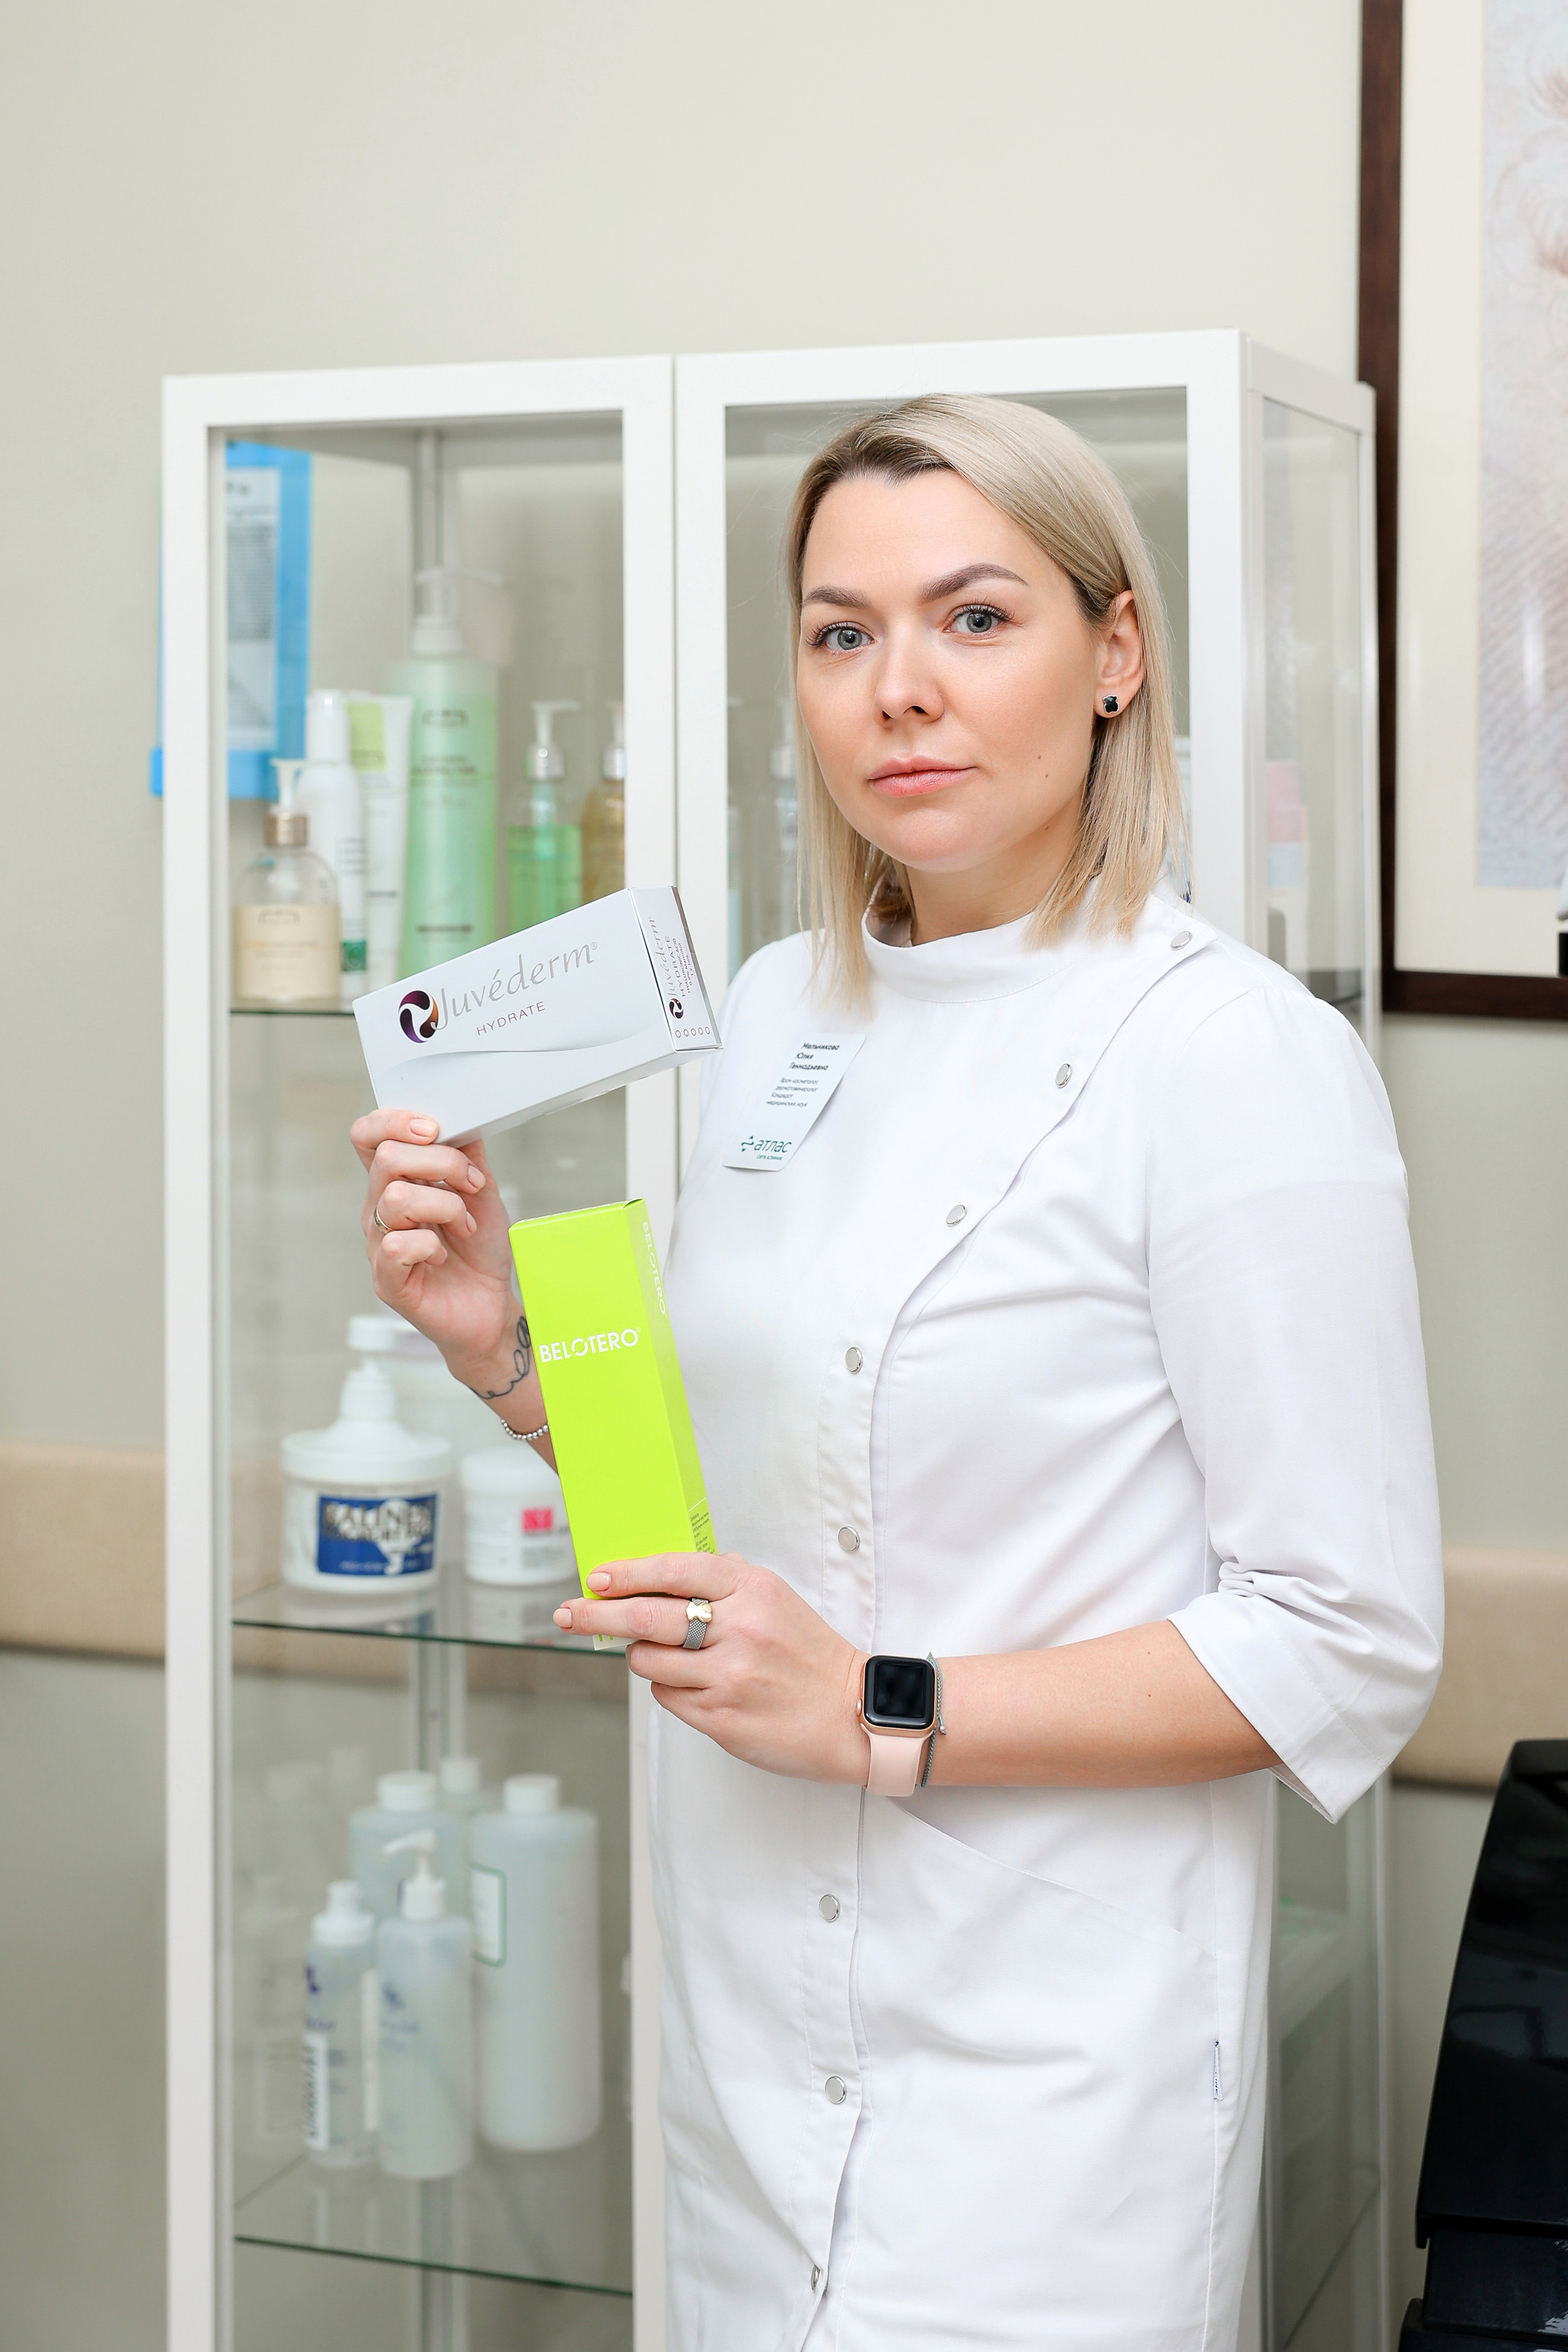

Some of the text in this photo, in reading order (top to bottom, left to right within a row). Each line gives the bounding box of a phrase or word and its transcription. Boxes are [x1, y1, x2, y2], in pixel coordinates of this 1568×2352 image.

[664, 935, 686, 997] HYDRATE
[677, 954, 691, 993] HYALURONIC
[678, 943, 688, 970] Mannitol
[476, 1000, 546, 1036] HYDRATE
[788, 1061, 829, 1071] Геннадьевна
[643, 1221, 666, 1316] BELOTERO
